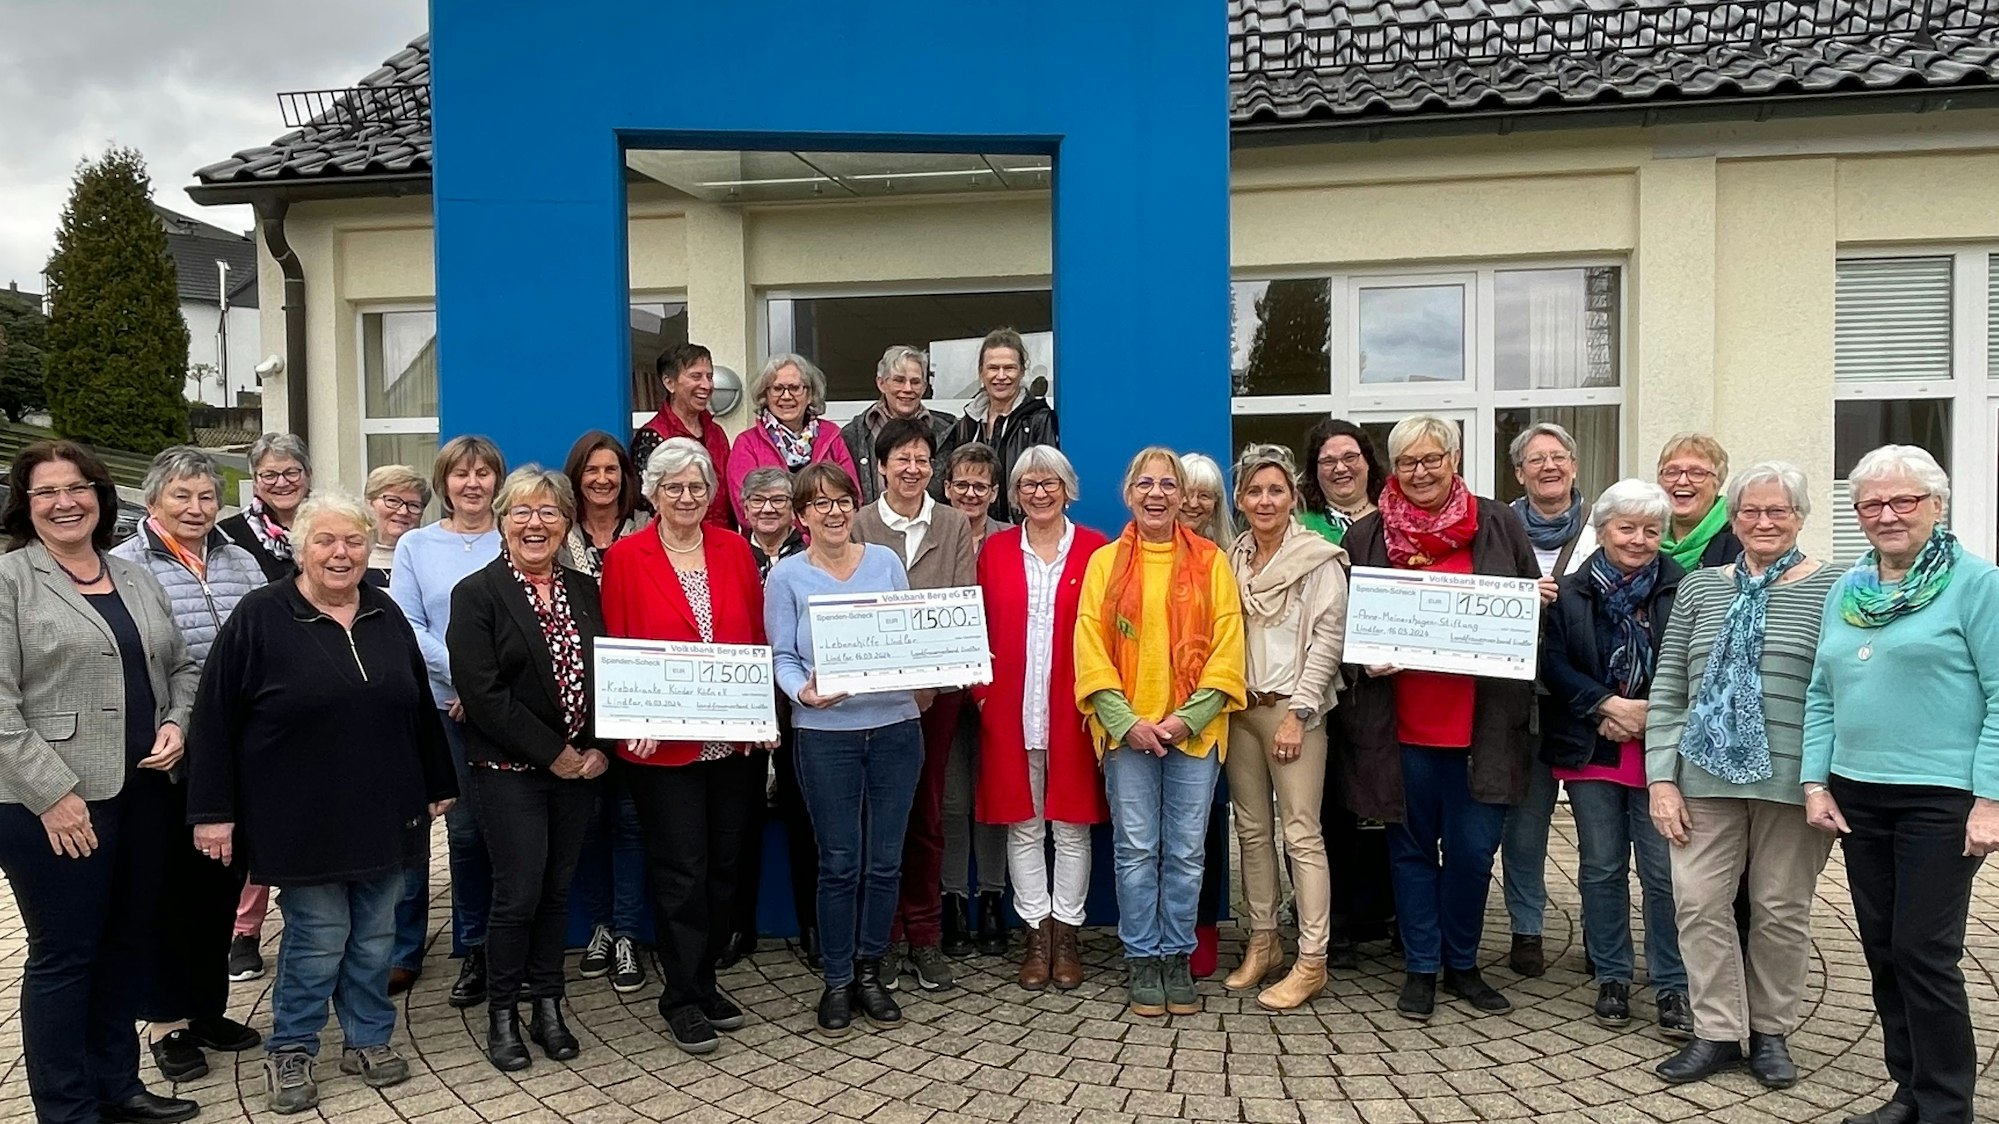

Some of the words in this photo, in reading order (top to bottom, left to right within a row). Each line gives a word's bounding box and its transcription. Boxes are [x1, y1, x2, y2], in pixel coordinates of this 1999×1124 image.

[1428, 575, 1476, 586] Volksbank
[1479, 579, 1500, 589] Berg
[1502, 581, 1516, 589] eG
[1355, 585, 1416, 596] Spenden-Scheck
[882, 593, 926, 603] Volksbank
[927, 592, 947, 602] Berg
[948, 590, 961, 599] eG
[816, 613, 874, 622] Spenden-Scheck
[671, 644, 714, 654] Volksbank
[717, 647, 737, 656] Berg
[601, 657, 661, 667] Spenden-Scheck
